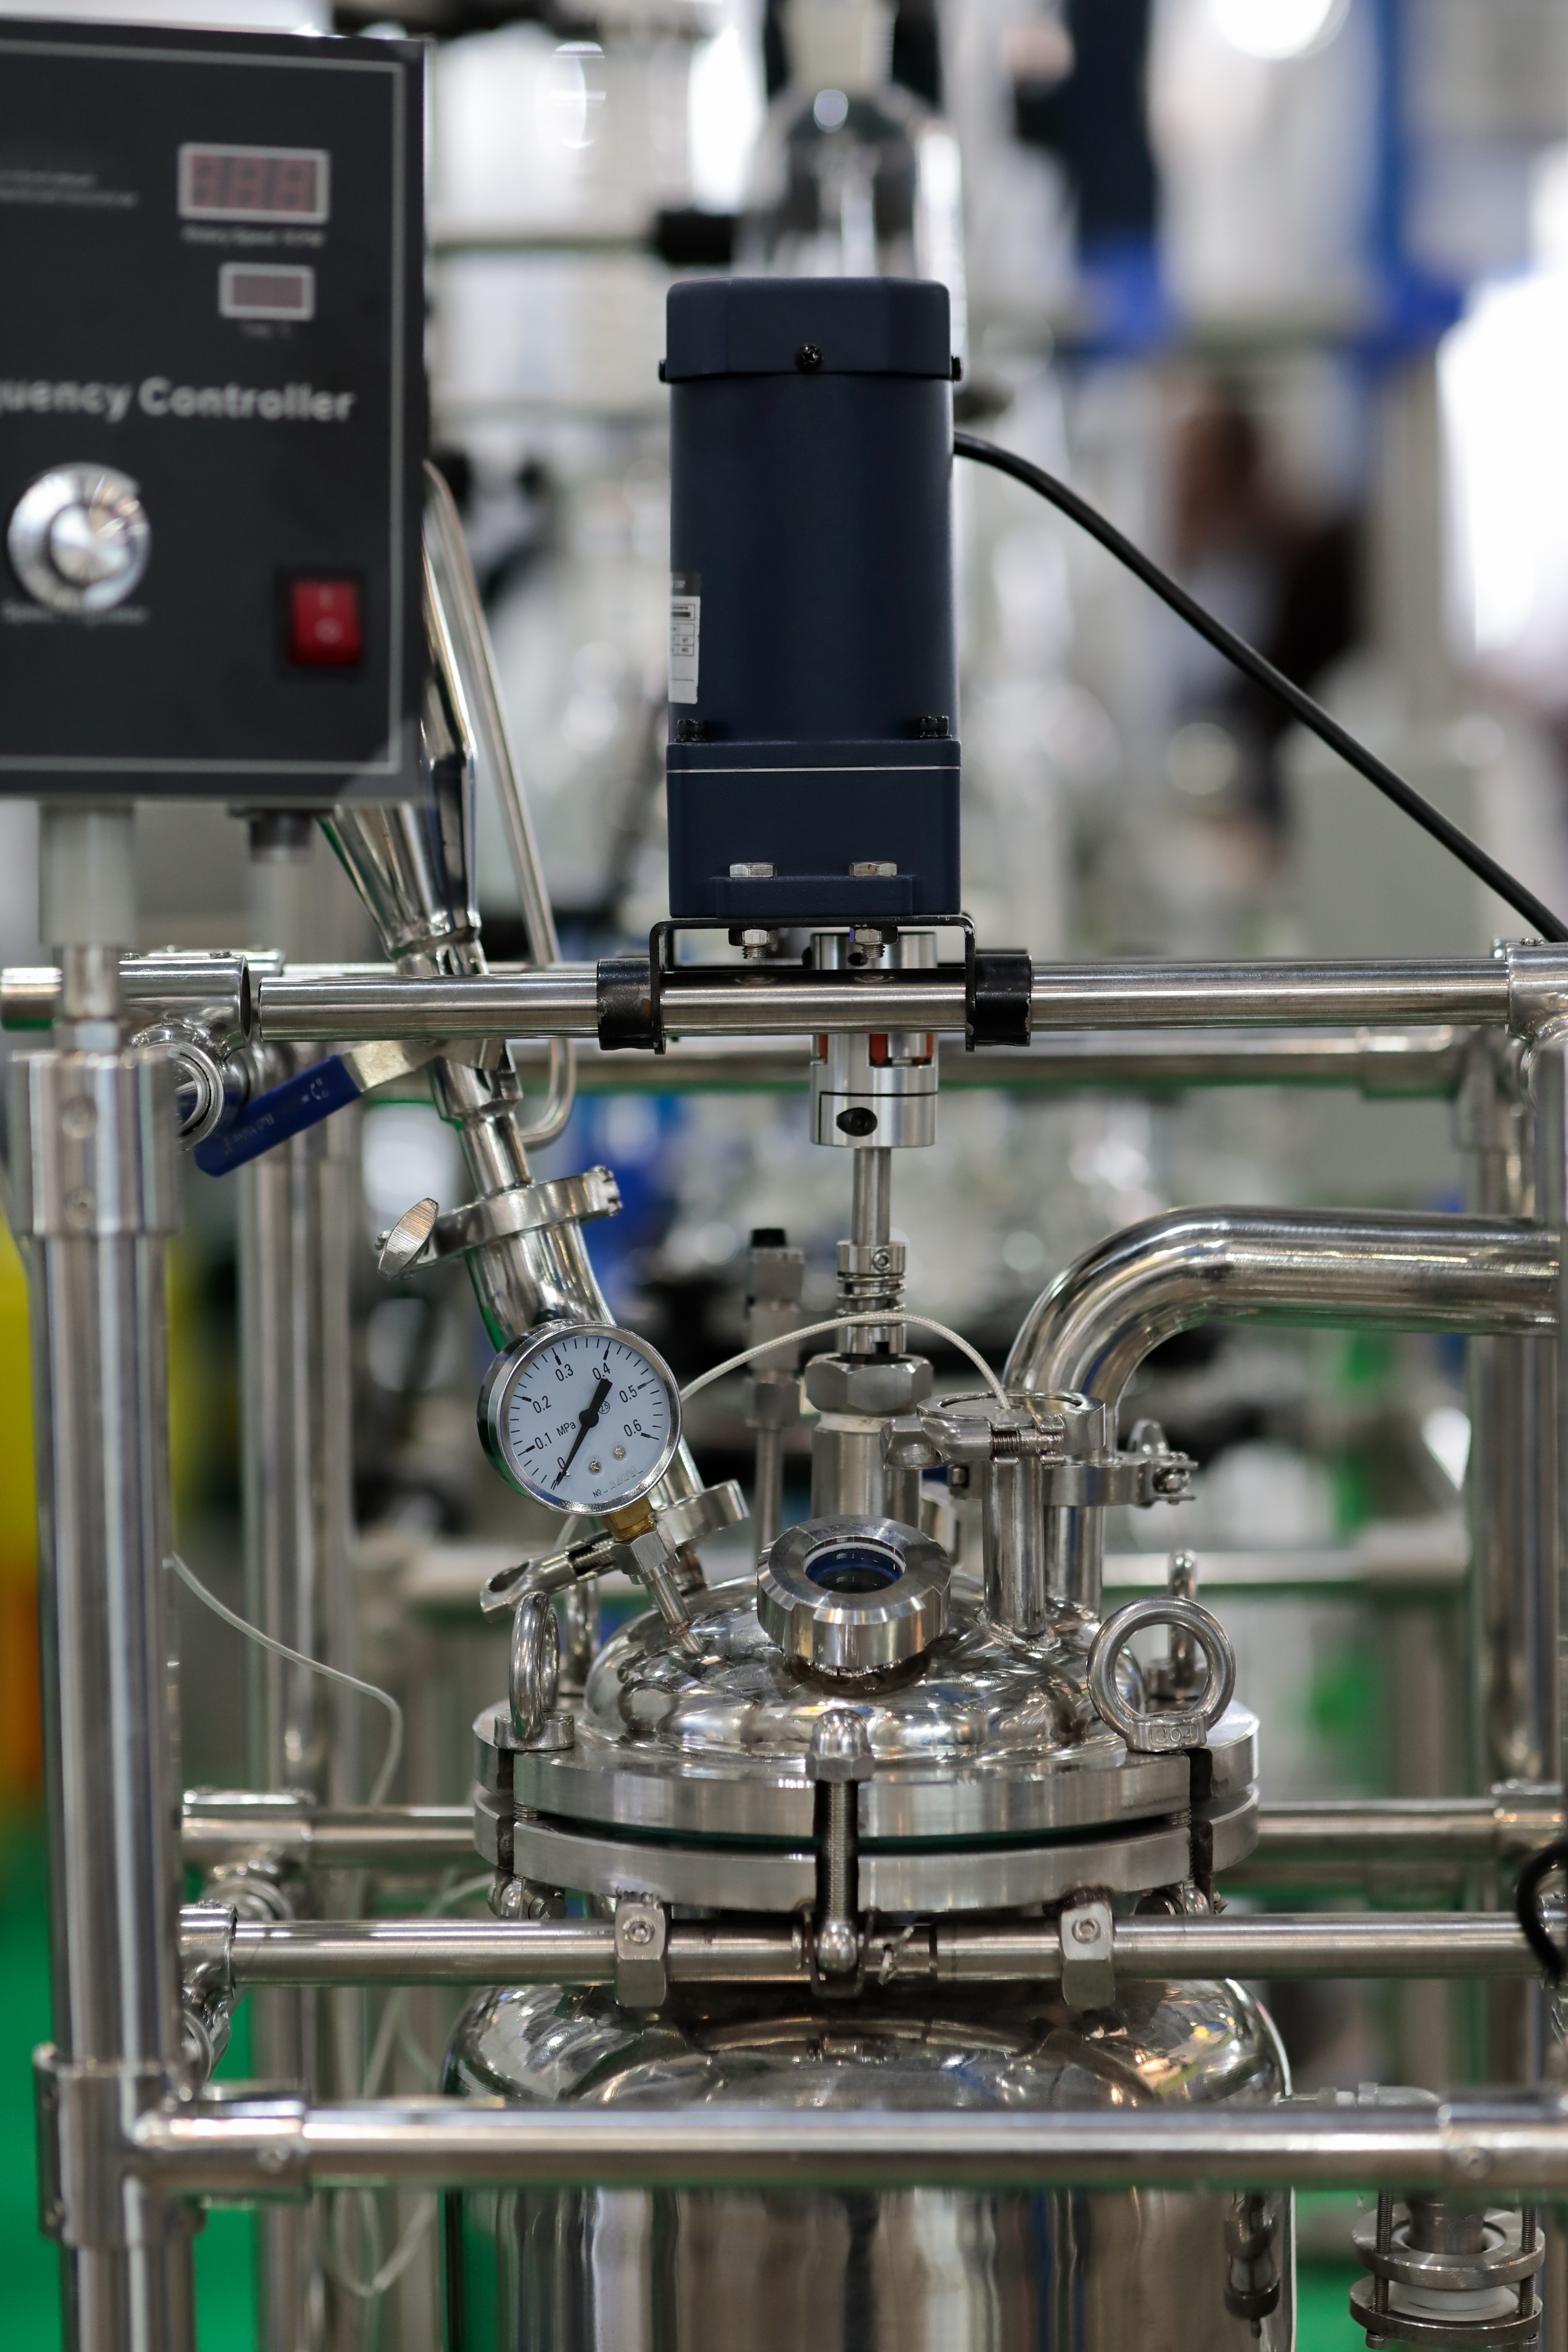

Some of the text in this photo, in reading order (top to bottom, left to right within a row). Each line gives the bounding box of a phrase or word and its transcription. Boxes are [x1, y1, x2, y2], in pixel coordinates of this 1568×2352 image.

[0, 376, 355, 423] uency Controller
[555, 1364, 574, 1381] 0.3
[592, 1362, 611, 1380] 0.4
[619, 1385, 637, 1403] 0.5
[532, 1395, 552, 1413] 0.2
[600, 1402, 609, 1412] 2.5
[556, 1422, 576, 1436] MPa
[624, 1419, 642, 1437] 0.6
[534, 1432, 552, 1449] 0.1
[557, 1457, 566, 1469] 0
[1155, 1726, 1193, 1744] 304
